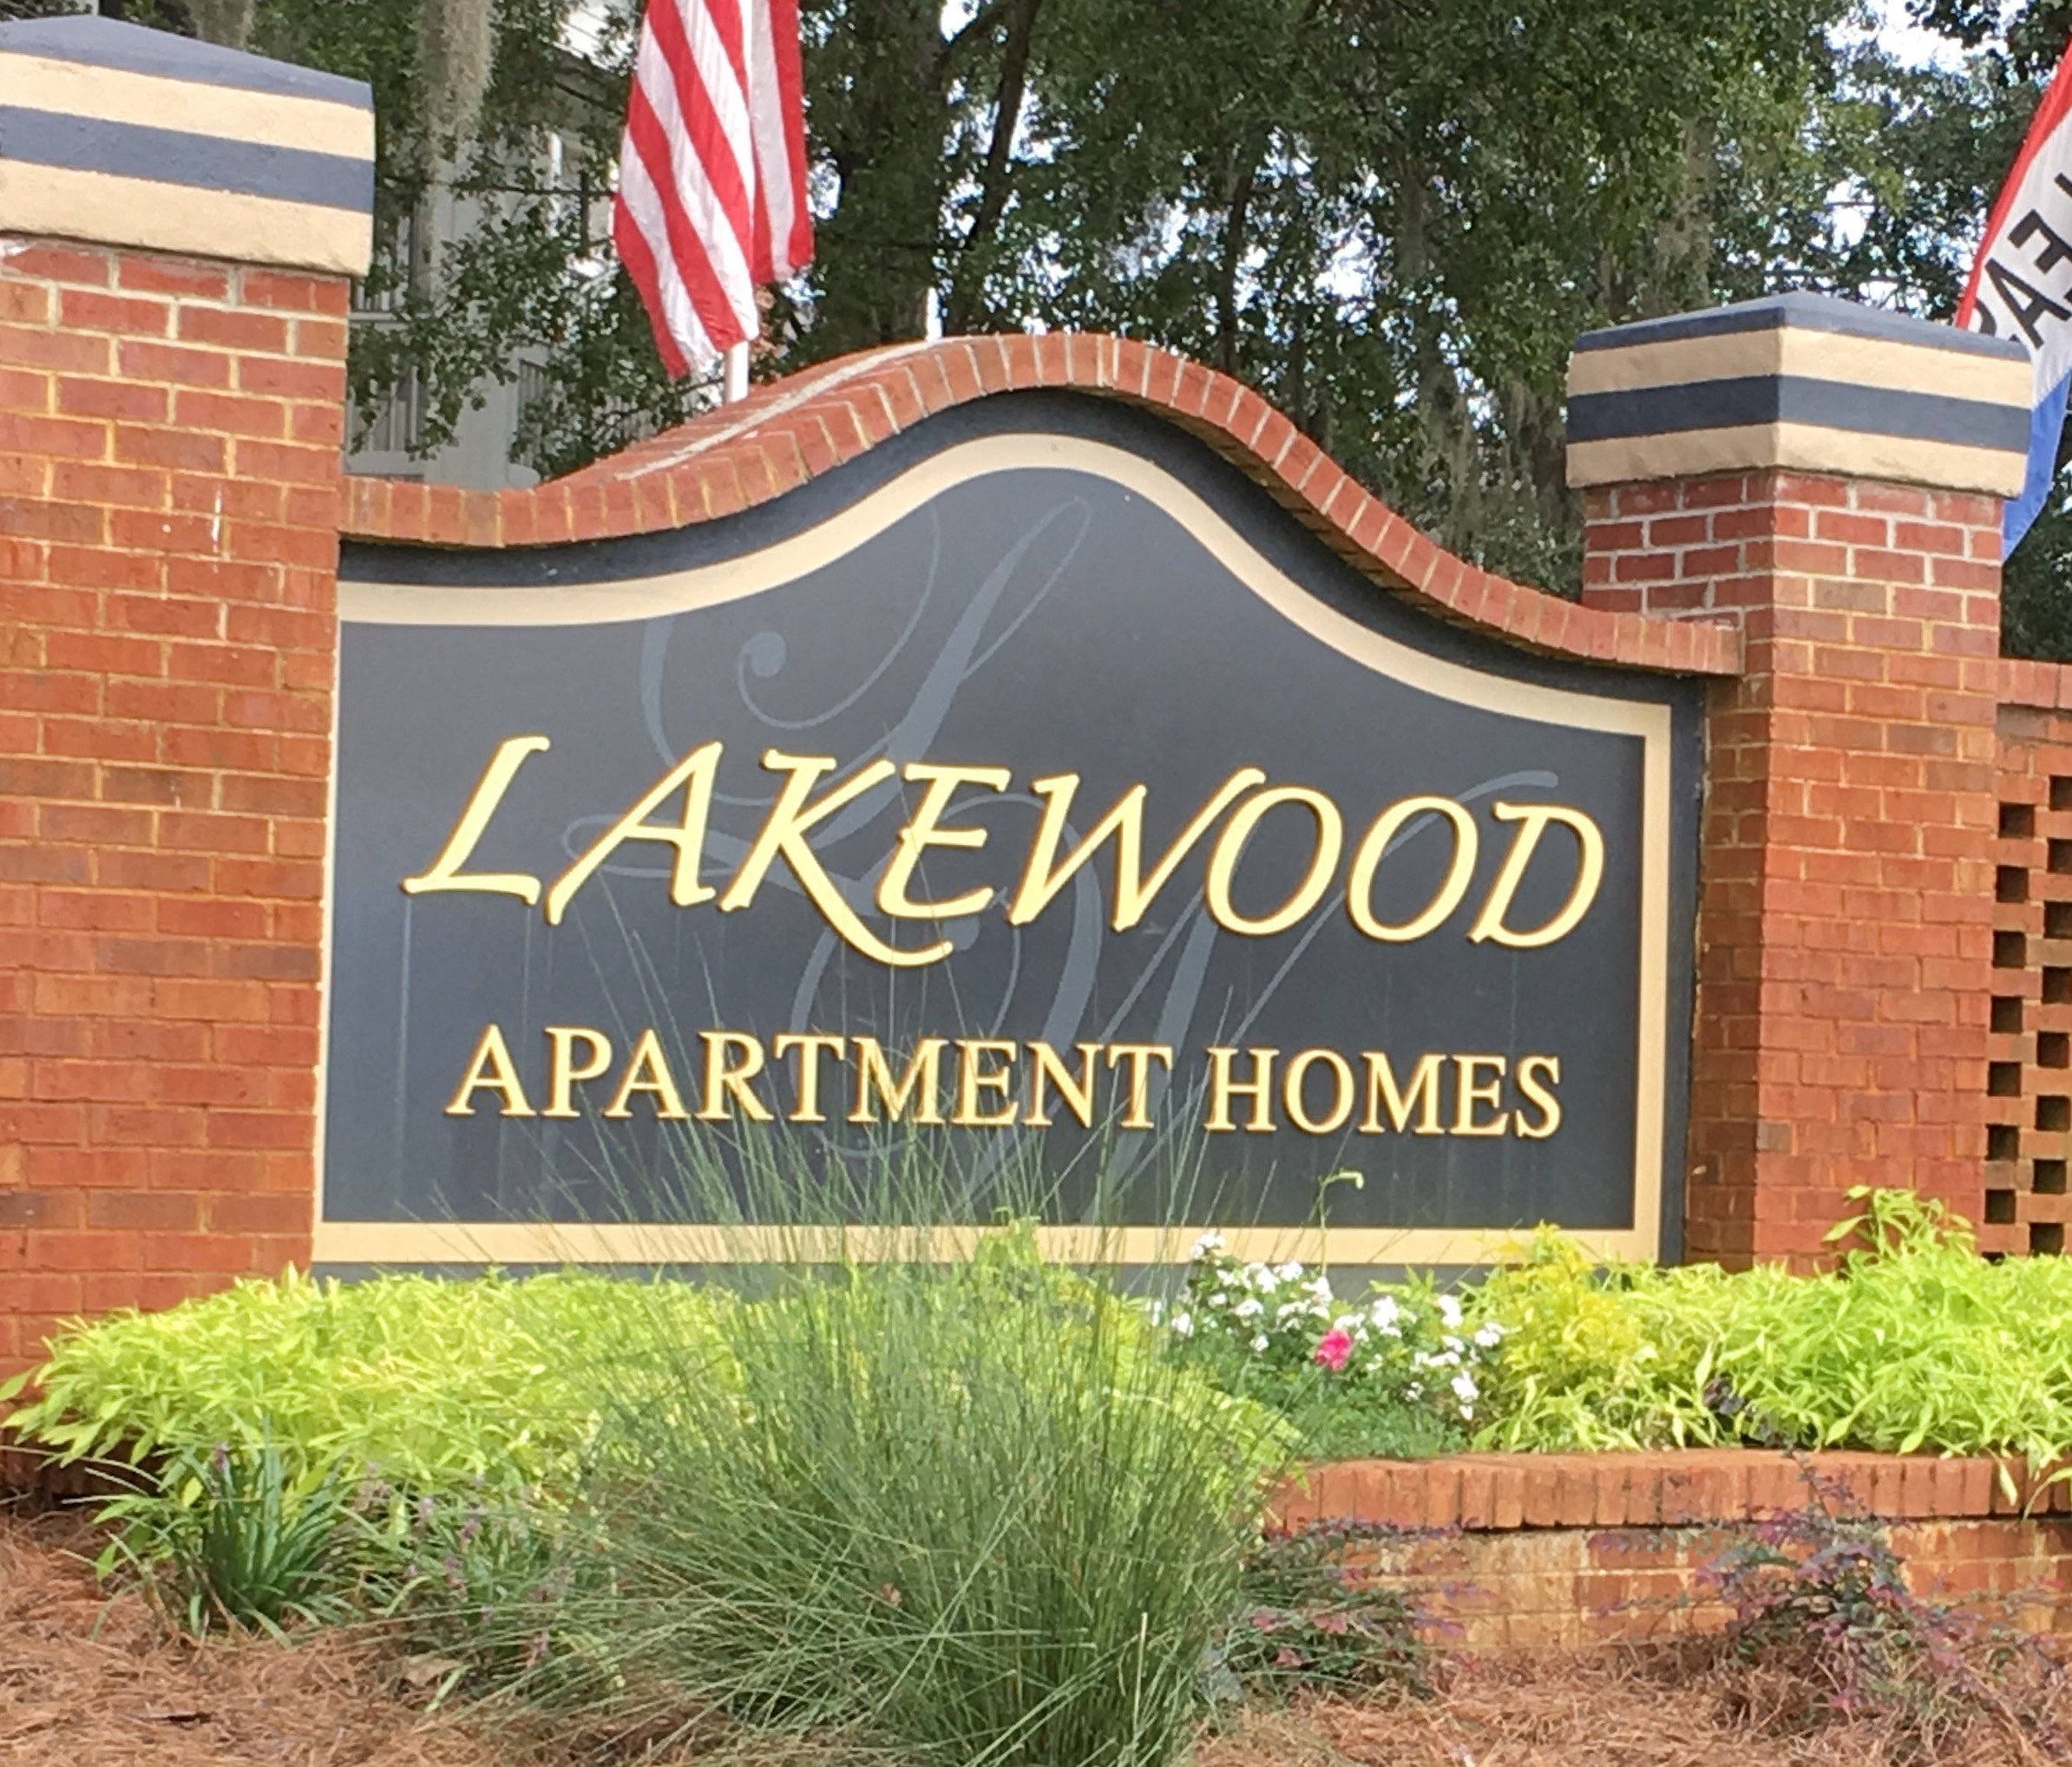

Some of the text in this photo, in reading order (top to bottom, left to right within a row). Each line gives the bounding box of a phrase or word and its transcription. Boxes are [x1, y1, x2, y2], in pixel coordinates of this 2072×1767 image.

[399, 733, 1608, 968] LAKEWOOD
[443, 1023, 1563, 1139] APARTMENT HOMES
